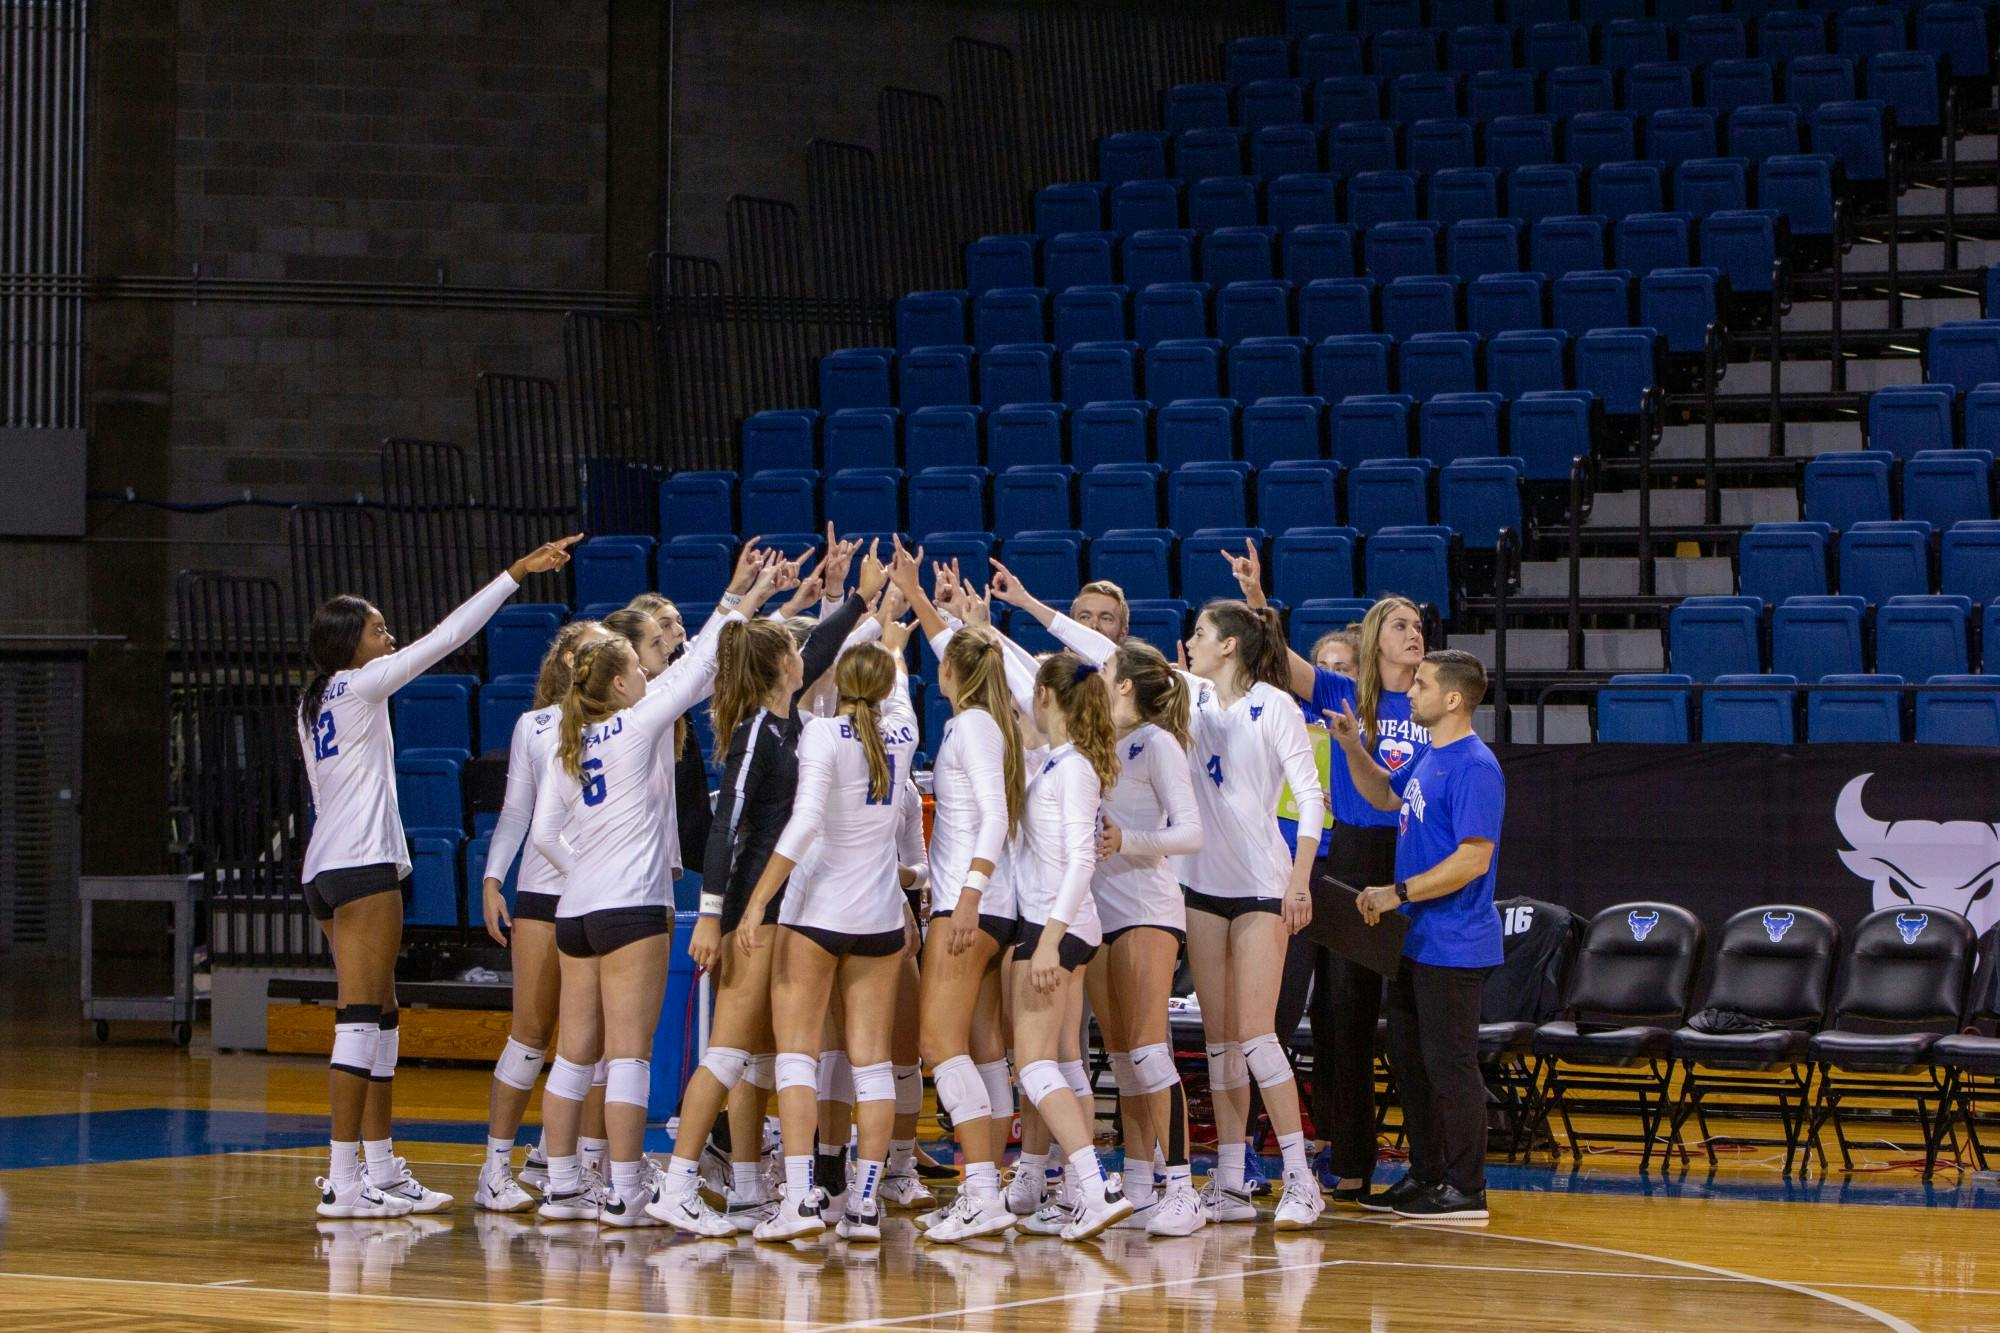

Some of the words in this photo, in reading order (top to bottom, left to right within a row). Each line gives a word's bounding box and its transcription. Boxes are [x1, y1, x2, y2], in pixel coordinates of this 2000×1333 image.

[312, 711, 339, 762] 12
[580, 758, 607, 807] 6
[1207, 754, 1223, 788] 4
[1504, 906, 1534, 936] 16
